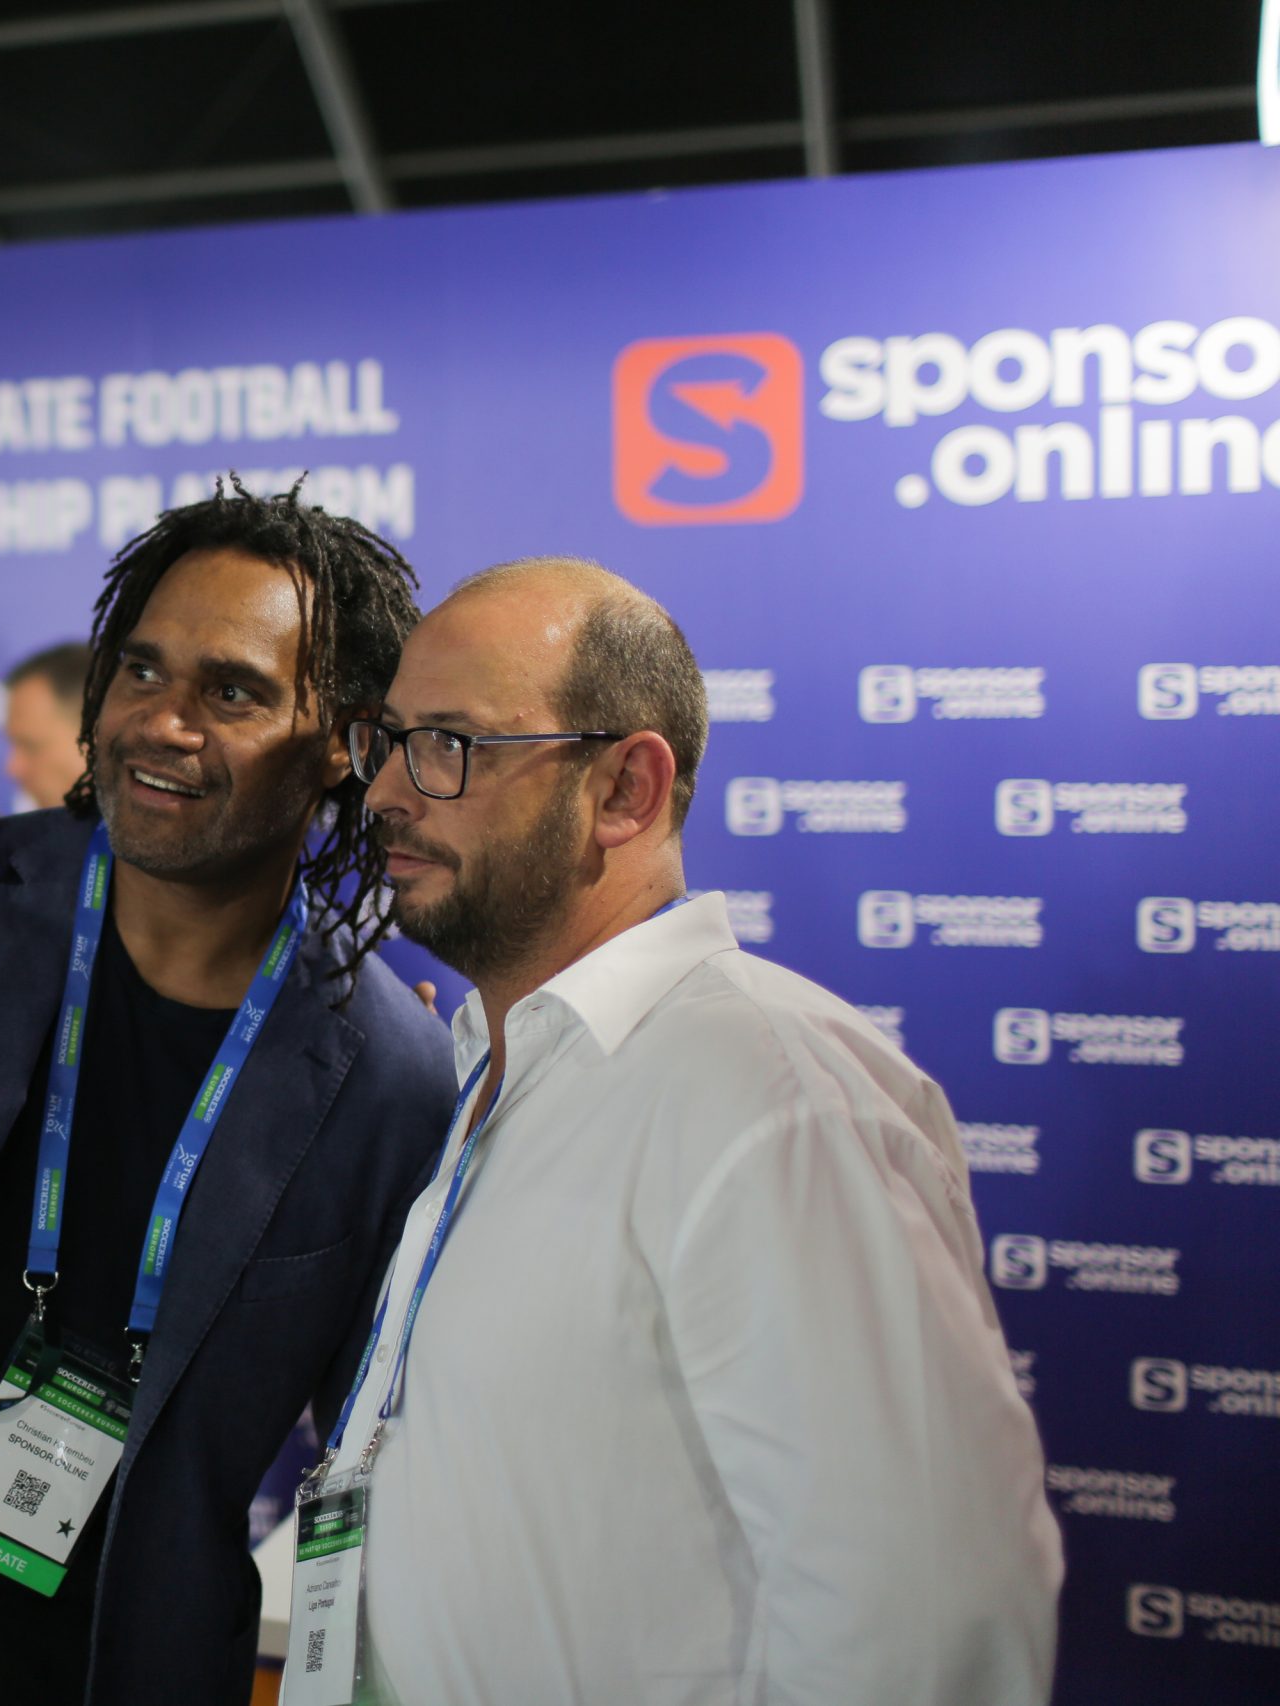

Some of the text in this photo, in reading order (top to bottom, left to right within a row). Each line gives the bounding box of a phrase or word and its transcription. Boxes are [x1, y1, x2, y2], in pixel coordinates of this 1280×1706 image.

[100, 359, 398, 450] FOOTBALL
[895, 402, 1280, 509] .onlin
[176, 1153, 199, 1192] TOTUM
[62, 1380, 93, 1401] EUROPE
[17, 1419, 95, 1467] Christian Krembeu
